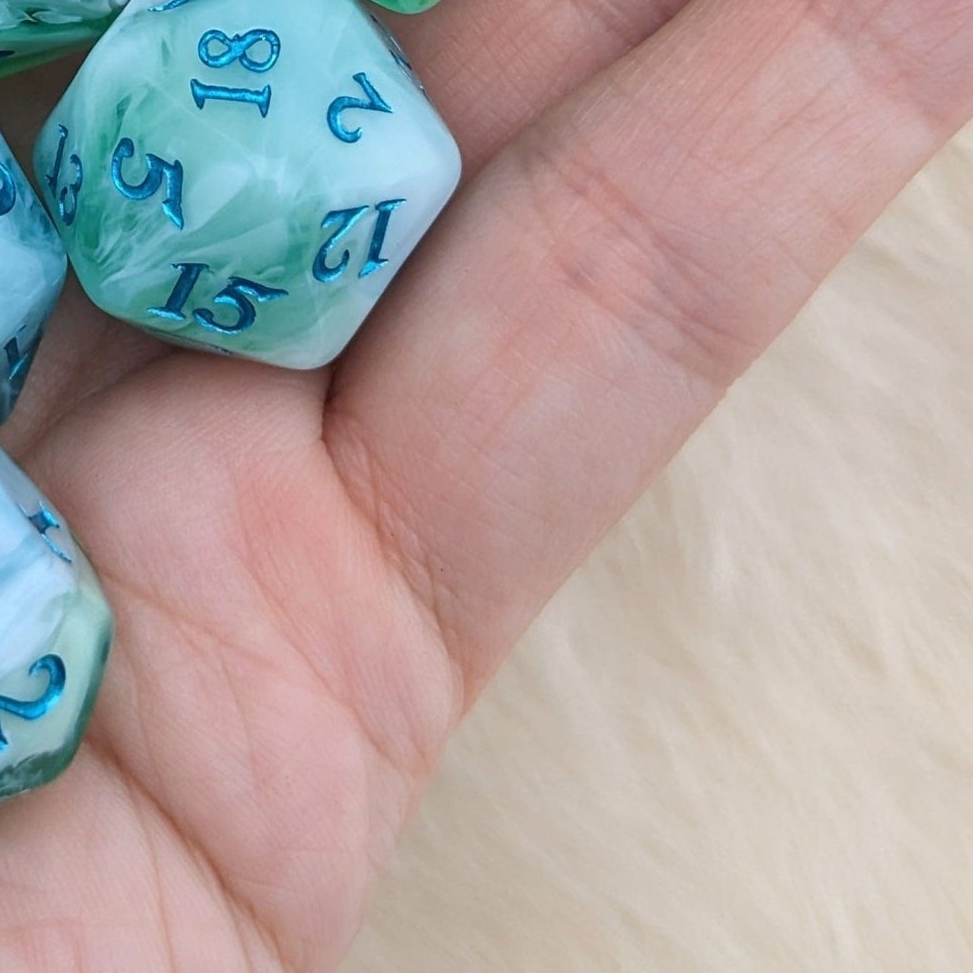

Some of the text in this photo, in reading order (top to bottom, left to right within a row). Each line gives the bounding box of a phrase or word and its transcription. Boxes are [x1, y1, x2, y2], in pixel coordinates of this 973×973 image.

[190, 28, 282, 118] 18
[327, 71, 394, 143] 2
[110, 137, 184, 230] 5
[312, 198, 408, 284] 12
[146, 263, 290, 335] 15
